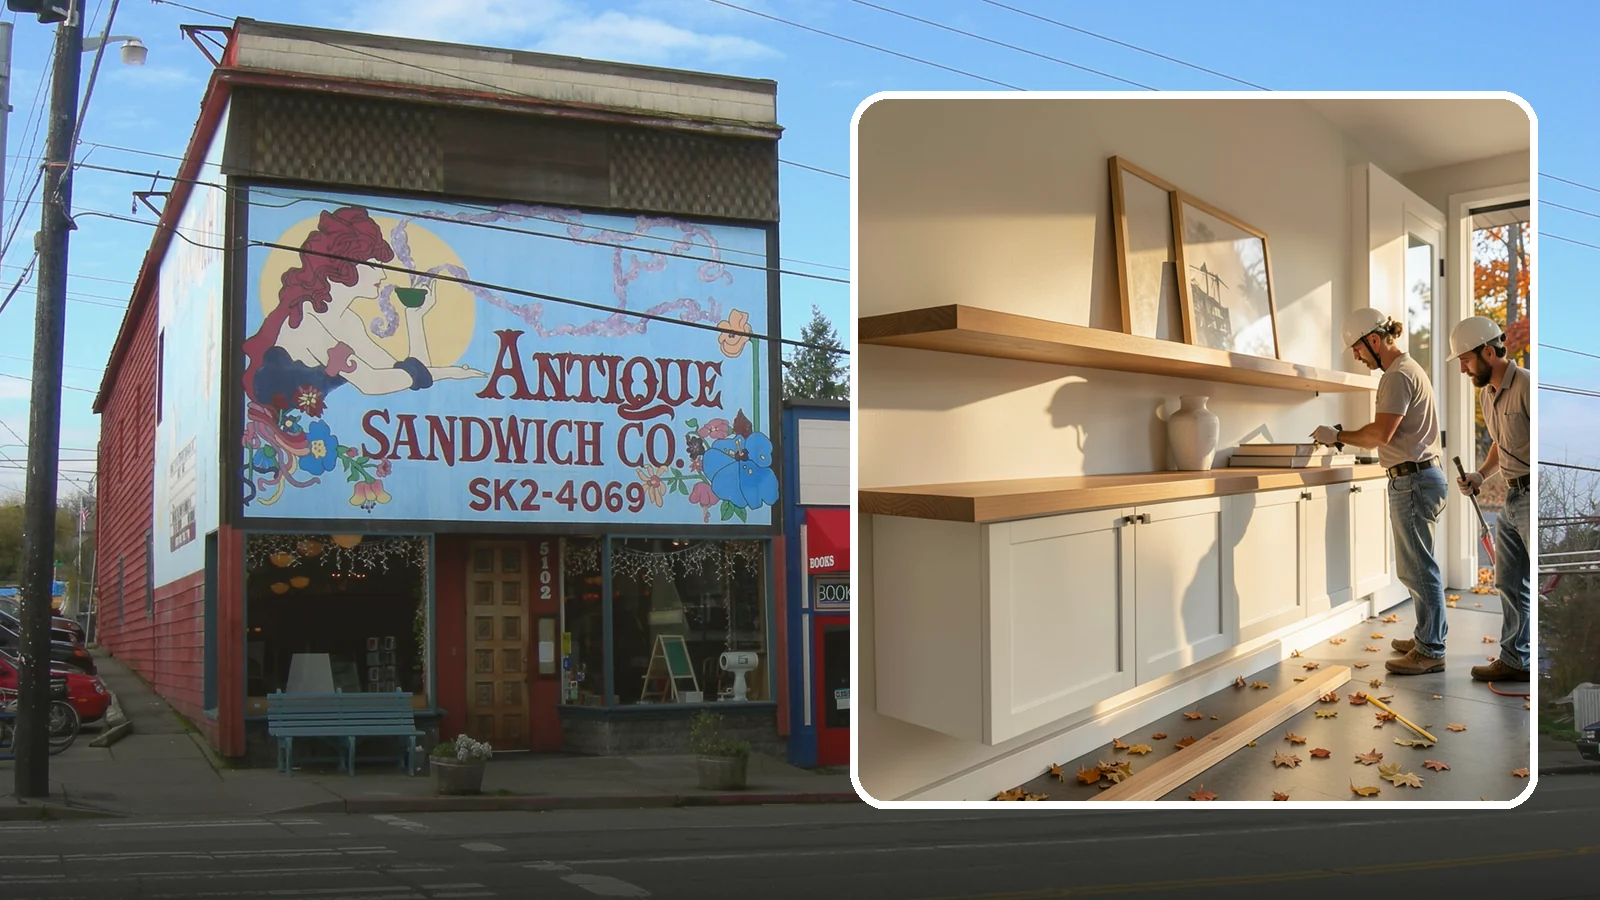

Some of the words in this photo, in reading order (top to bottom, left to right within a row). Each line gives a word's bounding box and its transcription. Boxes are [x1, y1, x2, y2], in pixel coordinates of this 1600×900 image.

[475, 328, 724, 421] ANTIQUE
[360, 408, 605, 468] SANDWICH
[616, 421, 686, 469] CO.
[468, 476, 646, 513] SK2-4069
[539, 541, 552, 600] 5102
[809, 554, 835, 569] BOOKS
